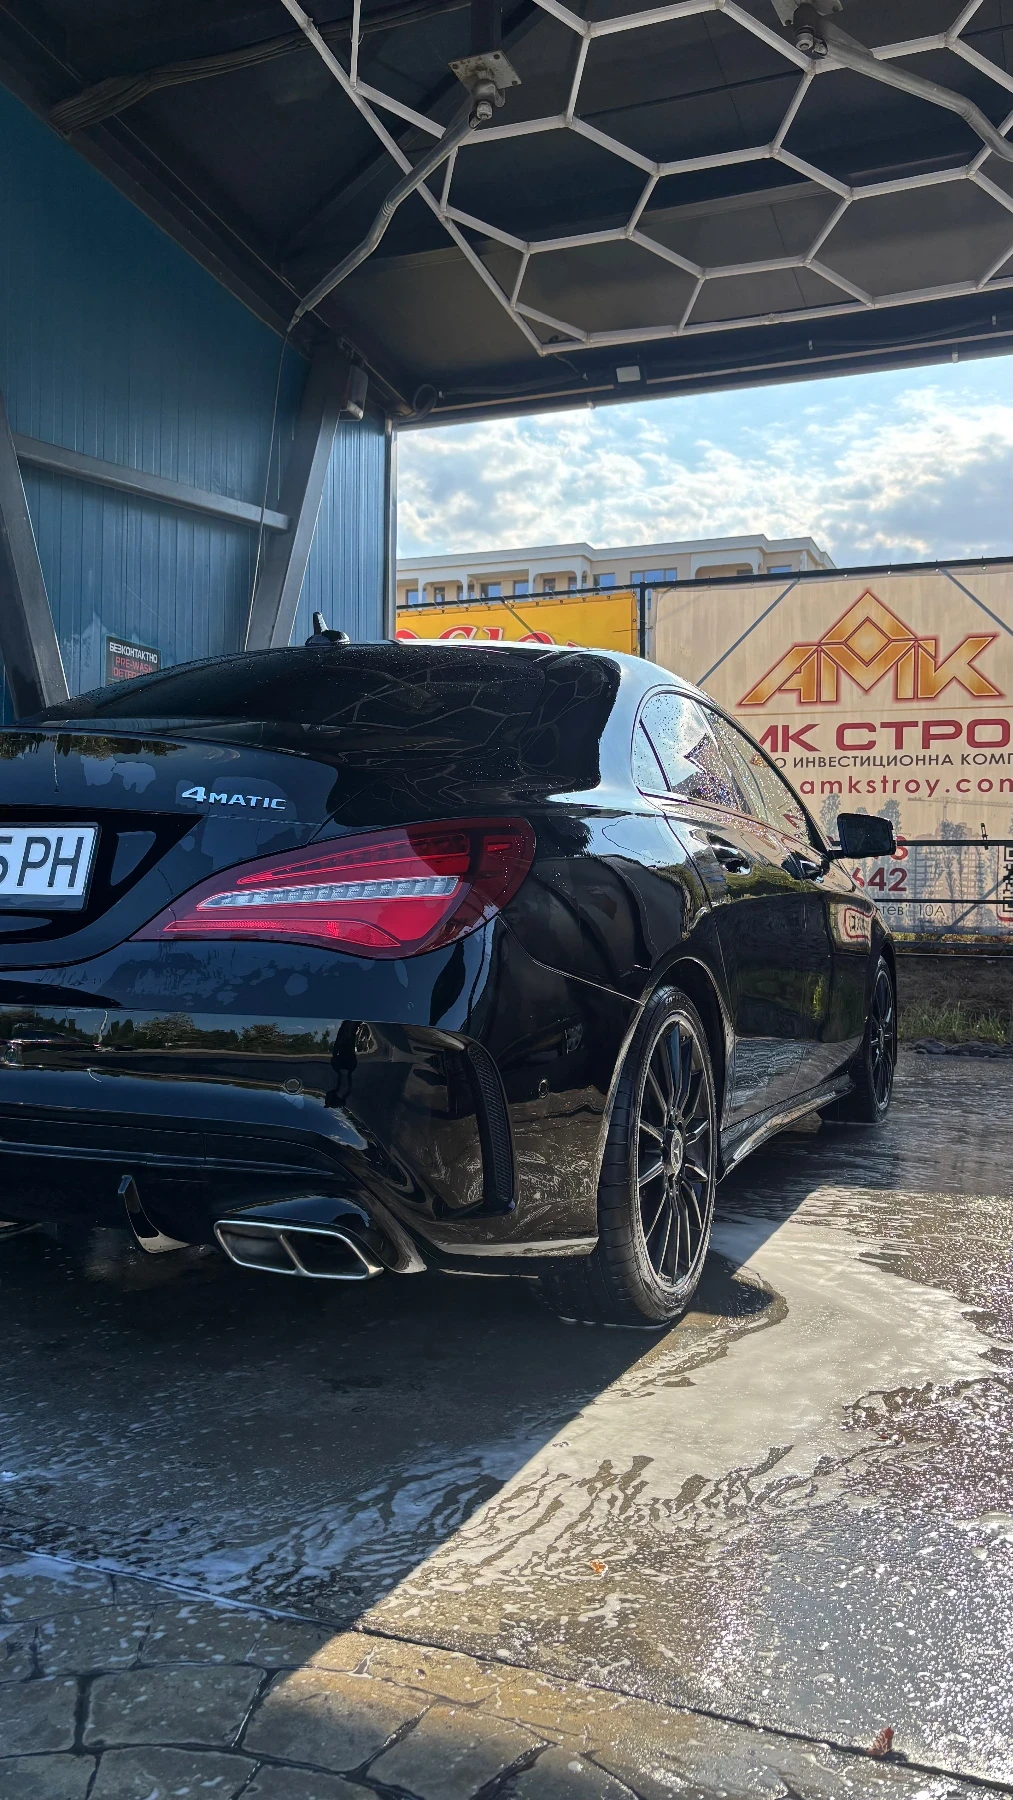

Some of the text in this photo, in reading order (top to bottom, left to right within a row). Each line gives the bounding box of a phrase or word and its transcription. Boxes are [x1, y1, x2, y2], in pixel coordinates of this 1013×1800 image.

[109, 642, 158, 663] БЕЗКОНТАКТНО
[115, 656, 153, 673] PRE-WASH
[793, 753, 954, 768] ИНВЕСТИЦИОННА
[181, 786, 287, 810] 4MATIC
